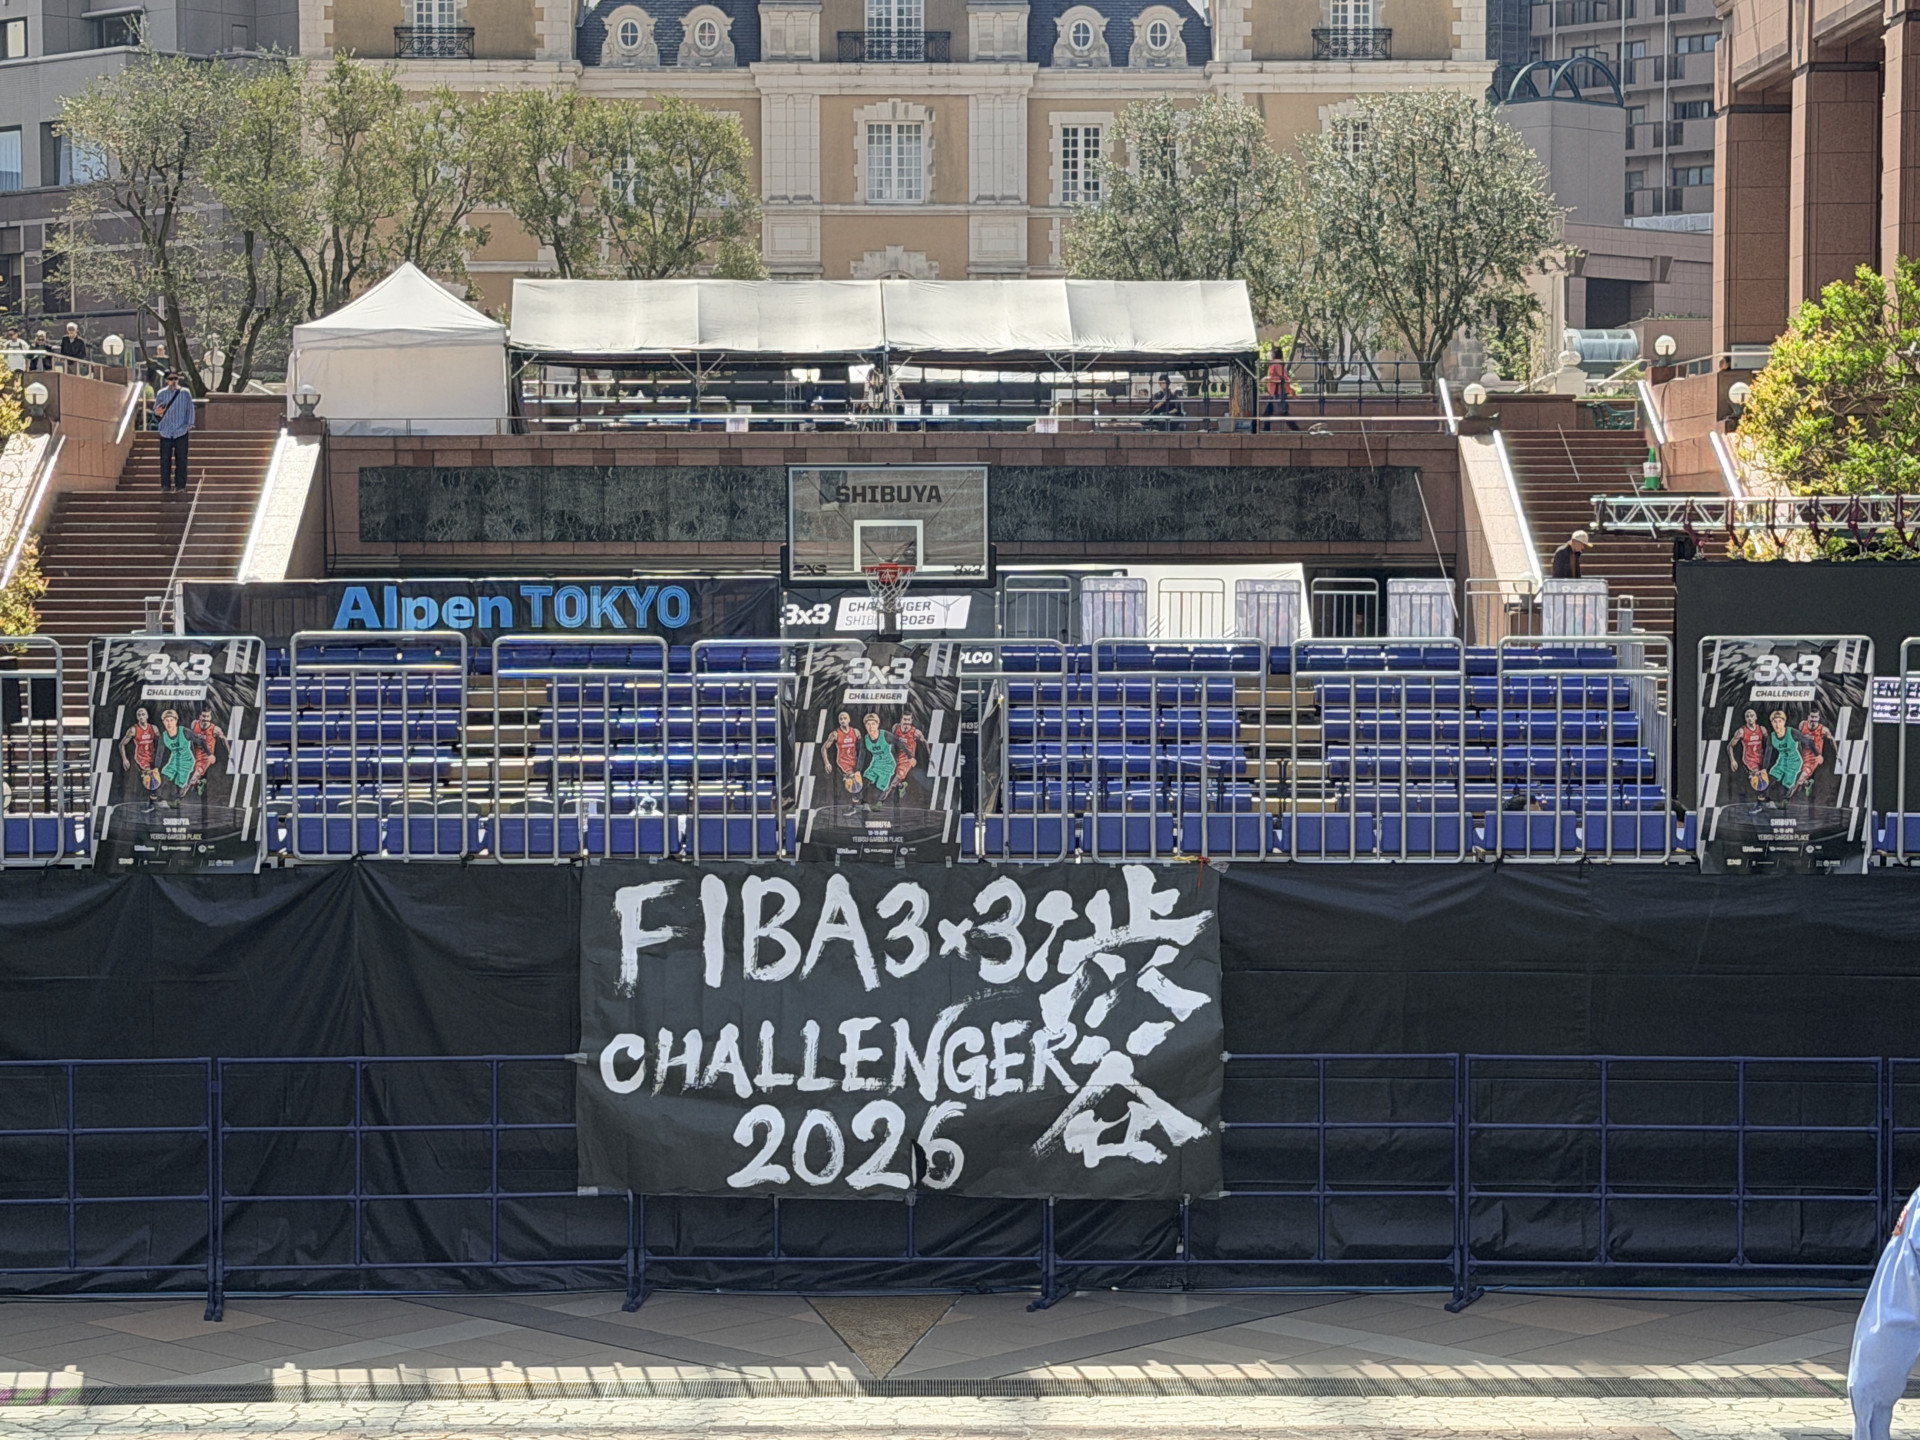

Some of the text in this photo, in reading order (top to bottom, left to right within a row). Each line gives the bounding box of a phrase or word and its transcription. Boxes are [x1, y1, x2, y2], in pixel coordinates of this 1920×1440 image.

[836, 485, 942, 503] SHIBUYA
[332, 585, 690, 629] Alpen TOKYO
[146, 688, 202, 697] CHALLENGER
[849, 692, 903, 700] CHALLENGER
[1755, 689, 1810, 698] CHALLENGER
[1027, 864, 1215, 1170] 渋谷
[599, 988, 1077, 1103] CHALLENGER
[727, 1099, 967, 1191] 2026
